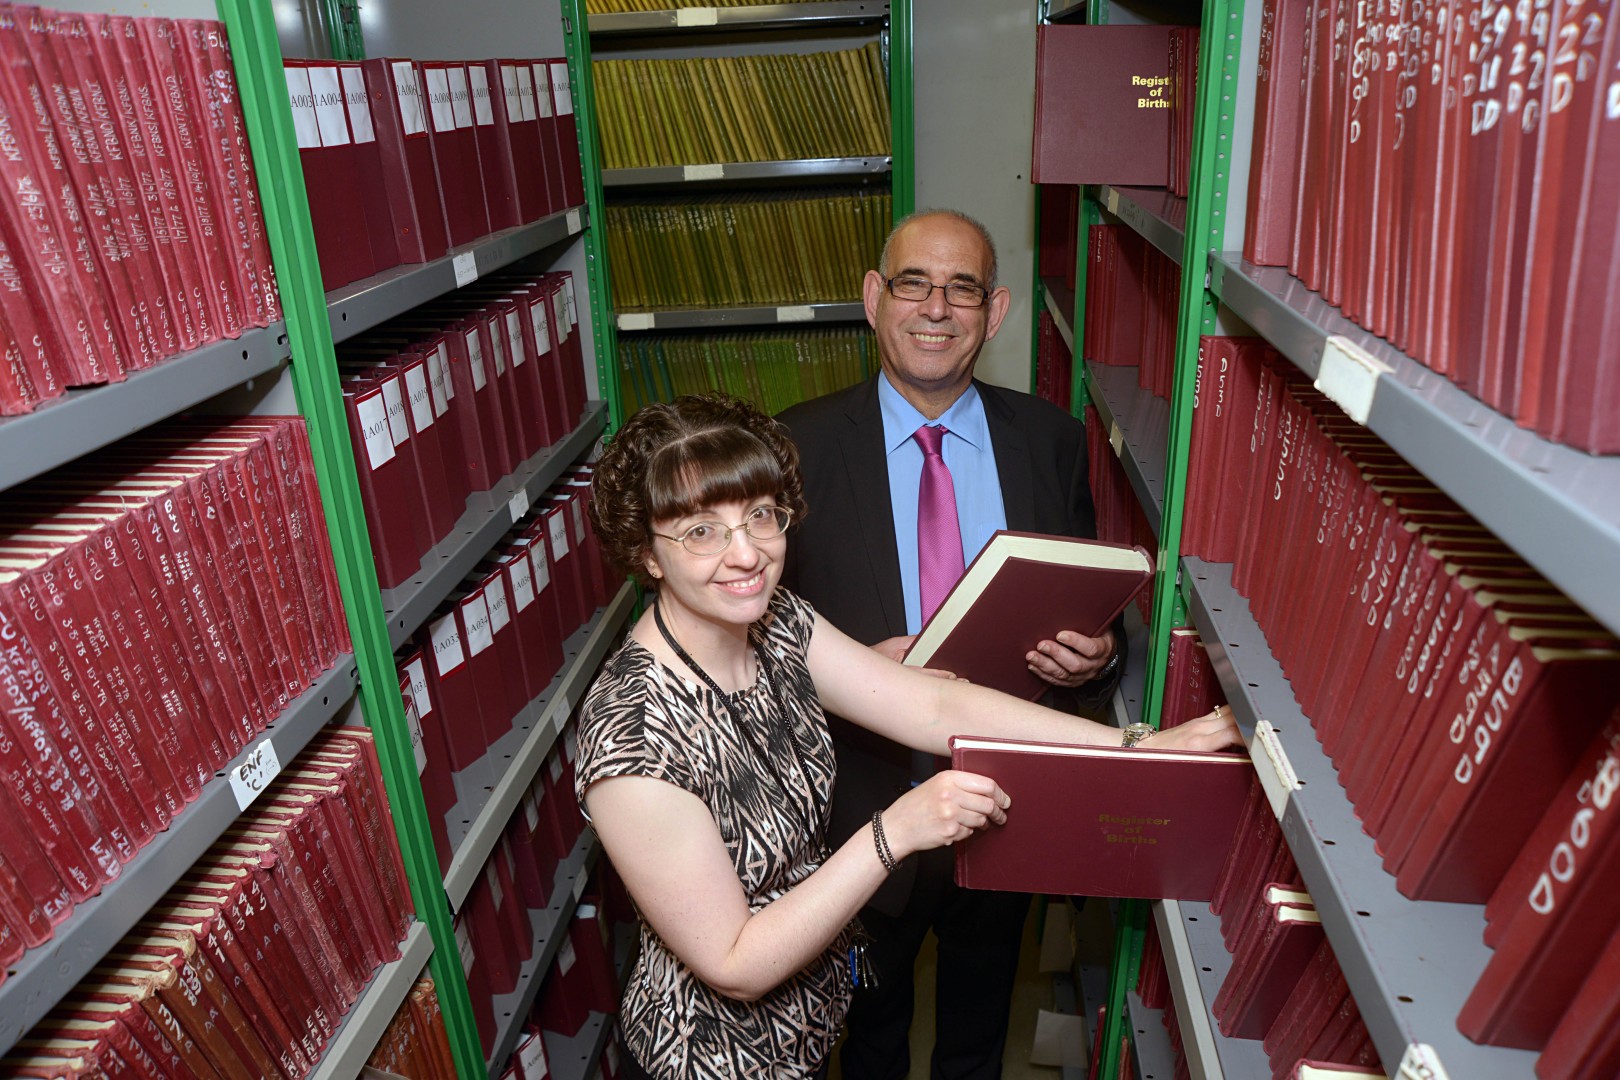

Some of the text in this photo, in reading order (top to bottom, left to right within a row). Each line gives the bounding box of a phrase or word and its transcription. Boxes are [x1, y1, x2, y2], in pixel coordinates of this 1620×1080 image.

[1132, 75, 1170, 88] Regist
[1149, 87, 1163, 97] of
[239, 750, 263, 782] ENF
